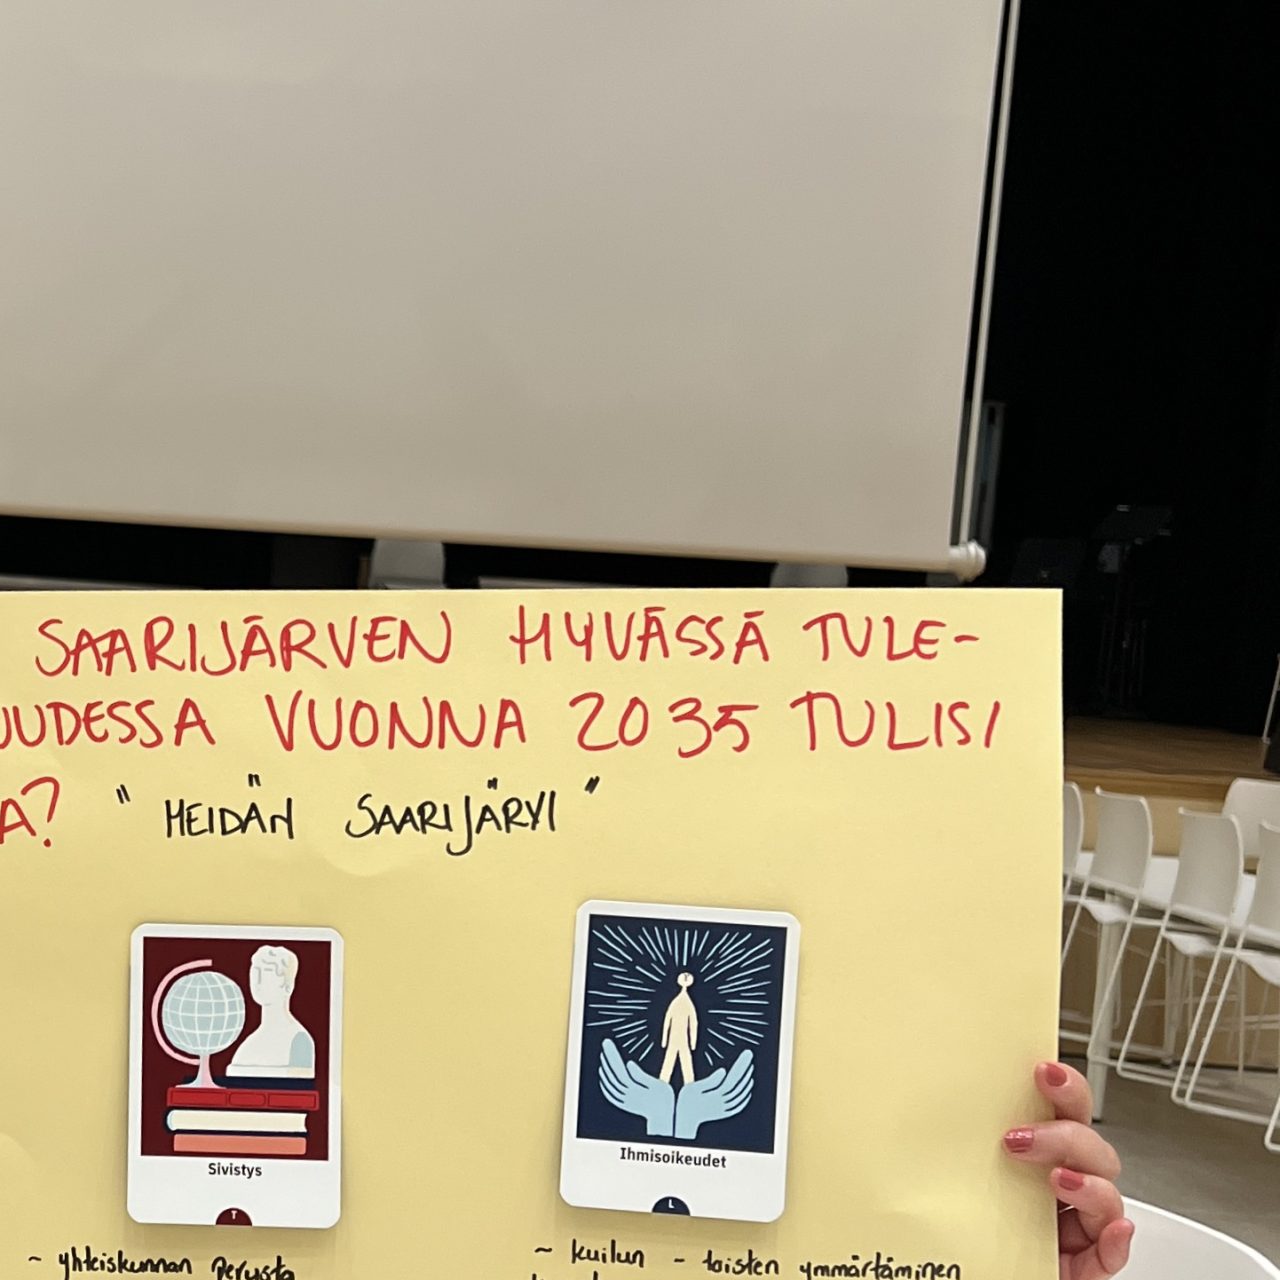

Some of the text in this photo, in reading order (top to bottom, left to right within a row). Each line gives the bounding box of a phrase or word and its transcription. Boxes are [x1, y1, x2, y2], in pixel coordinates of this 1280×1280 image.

[35, 612, 452, 677] SAARIJÄRVEN
[510, 606, 770, 665] HYVÄSSÄ
[803, 612, 977, 662] TULE-
[265, 690, 526, 752] VUONNA
[569, 691, 757, 759] 2035
[789, 691, 1001, 752] TULISI
[619, 1147, 727, 1169] Ihmisoikeudet
[208, 1162, 262, 1179] Sivistys
[231, 1210, 237, 1219] T
[668, 1199, 675, 1209] L
[571, 1238, 645, 1268] kuilun
